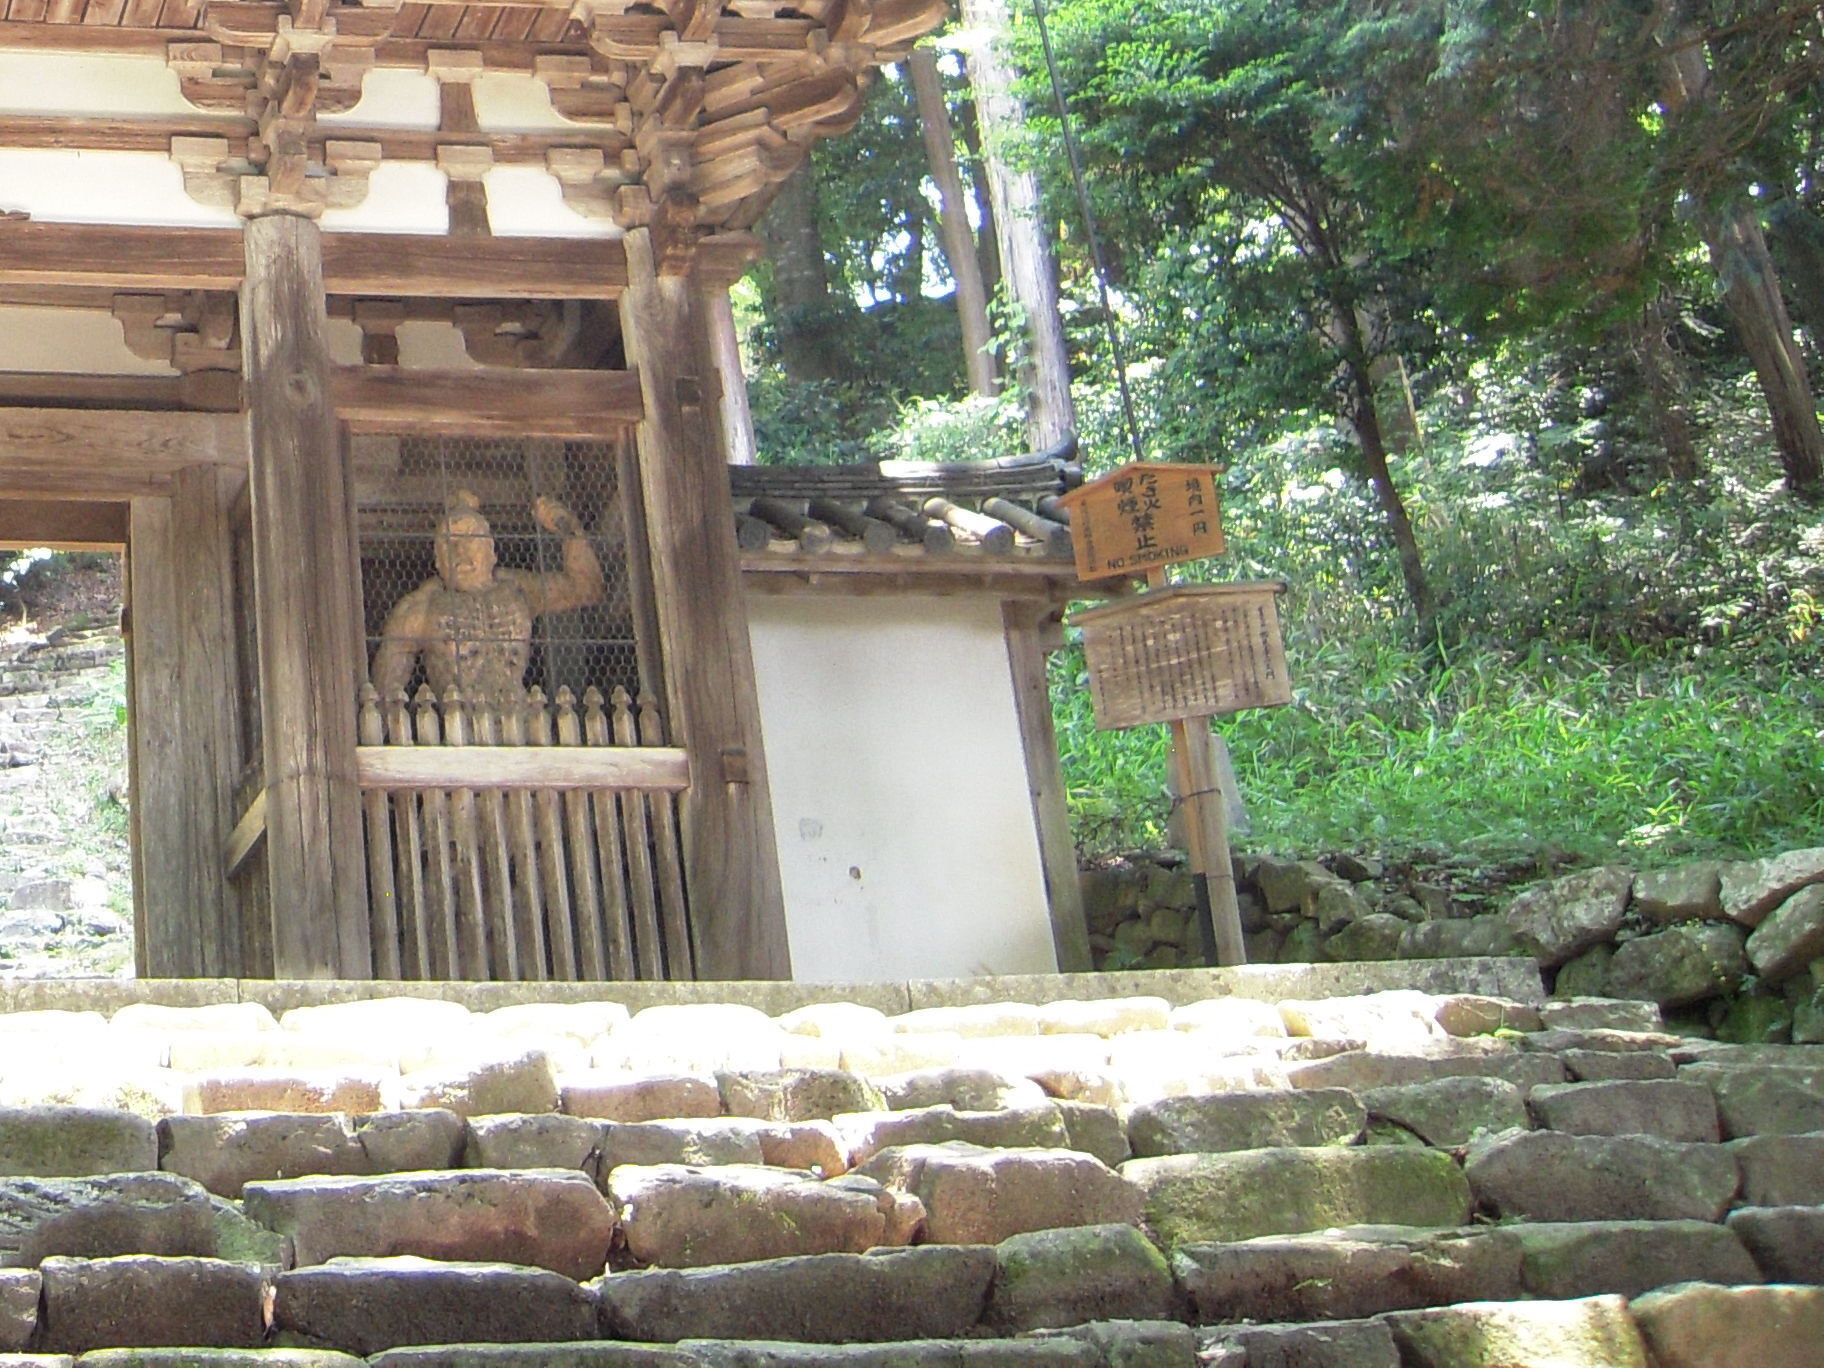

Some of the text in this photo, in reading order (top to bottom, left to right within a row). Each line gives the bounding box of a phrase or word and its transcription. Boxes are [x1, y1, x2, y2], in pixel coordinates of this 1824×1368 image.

[1113, 477, 1140, 516] 喫煙
[1139, 473, 1162, 514] たき火
[1185, 477, 1207, 536] 境内一円
[1131, 513, 1158, 551] 禁止
[1107, 544, 1189, 570] NO SMOKING
